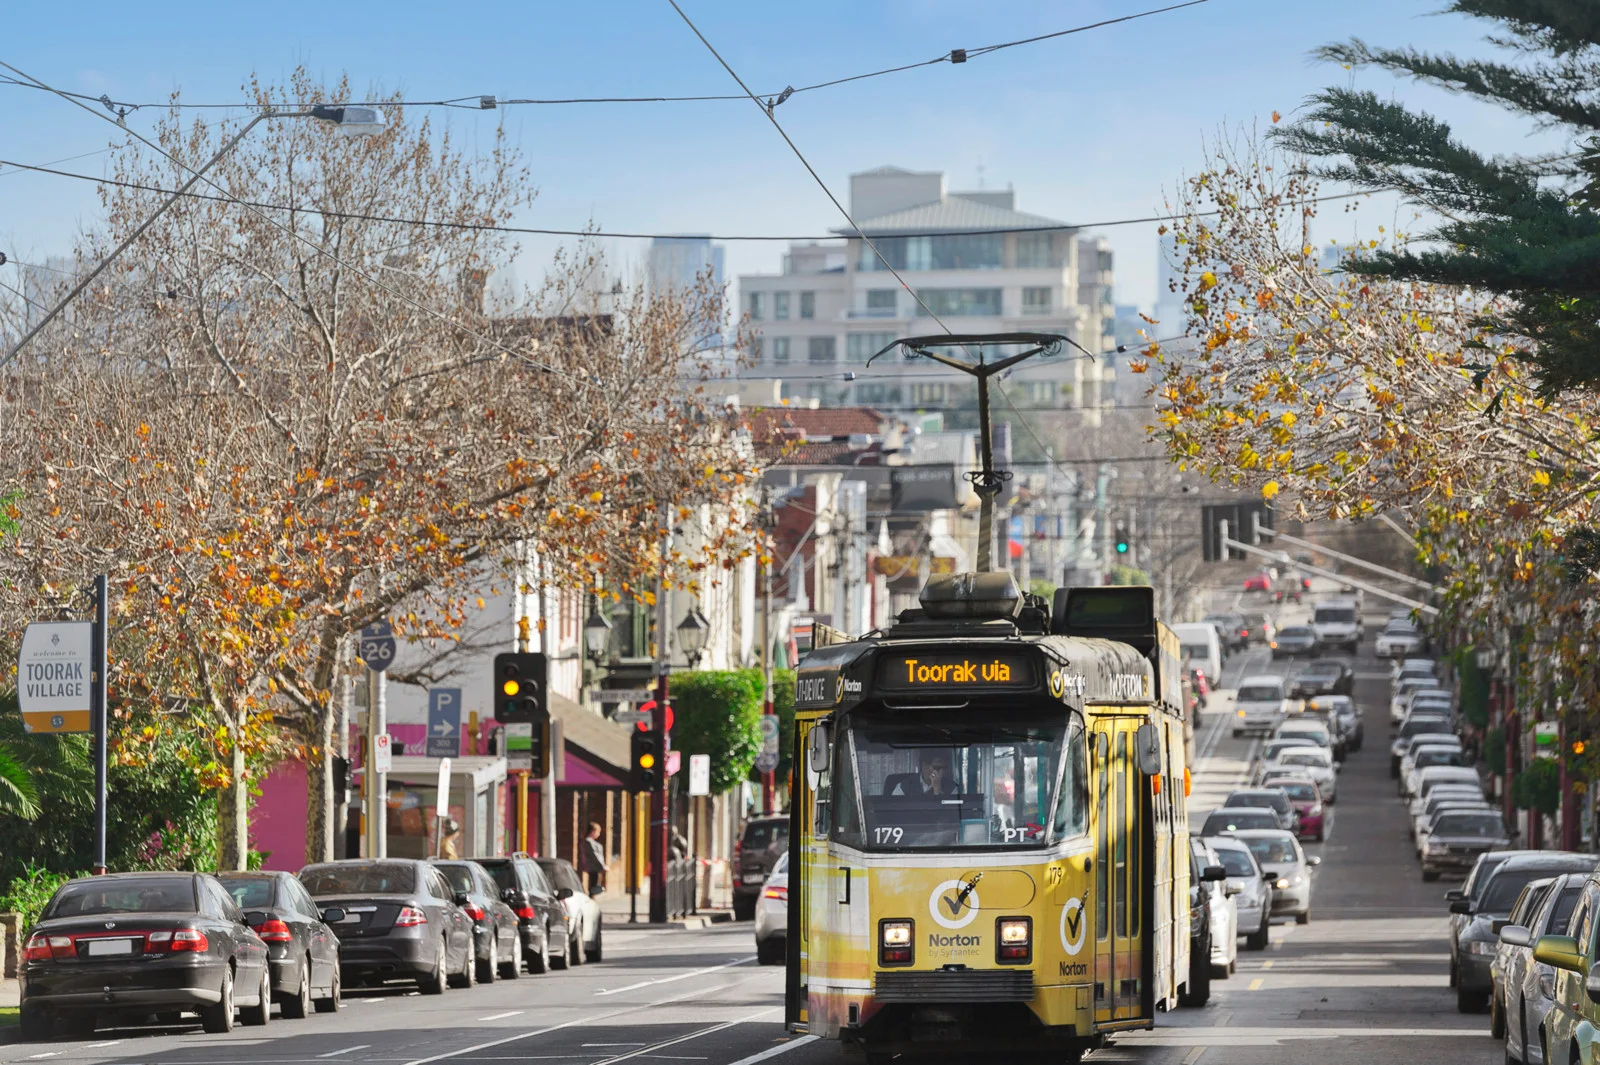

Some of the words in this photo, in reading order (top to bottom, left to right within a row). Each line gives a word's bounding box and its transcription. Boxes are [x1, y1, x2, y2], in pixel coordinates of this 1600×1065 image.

[366, 642, 391, 660] 26
[26, 662, 83, 680] TOORAK
[905, 659, 977, 682] Toorak
[981, 660, 1010, 681] via
[26, 683, 83, 697] VILLAGE
[844, 679, 862, 692] Norton
[1109, 674, 1142, 696] NORTON
[437, 693, 452, 711] P
[874, 827, 903, 844] 179
[1049, 867, 1062, 885] 179
[929, 934, 980, 947] Norton
[1059, 961, 1086, 976] Norton
